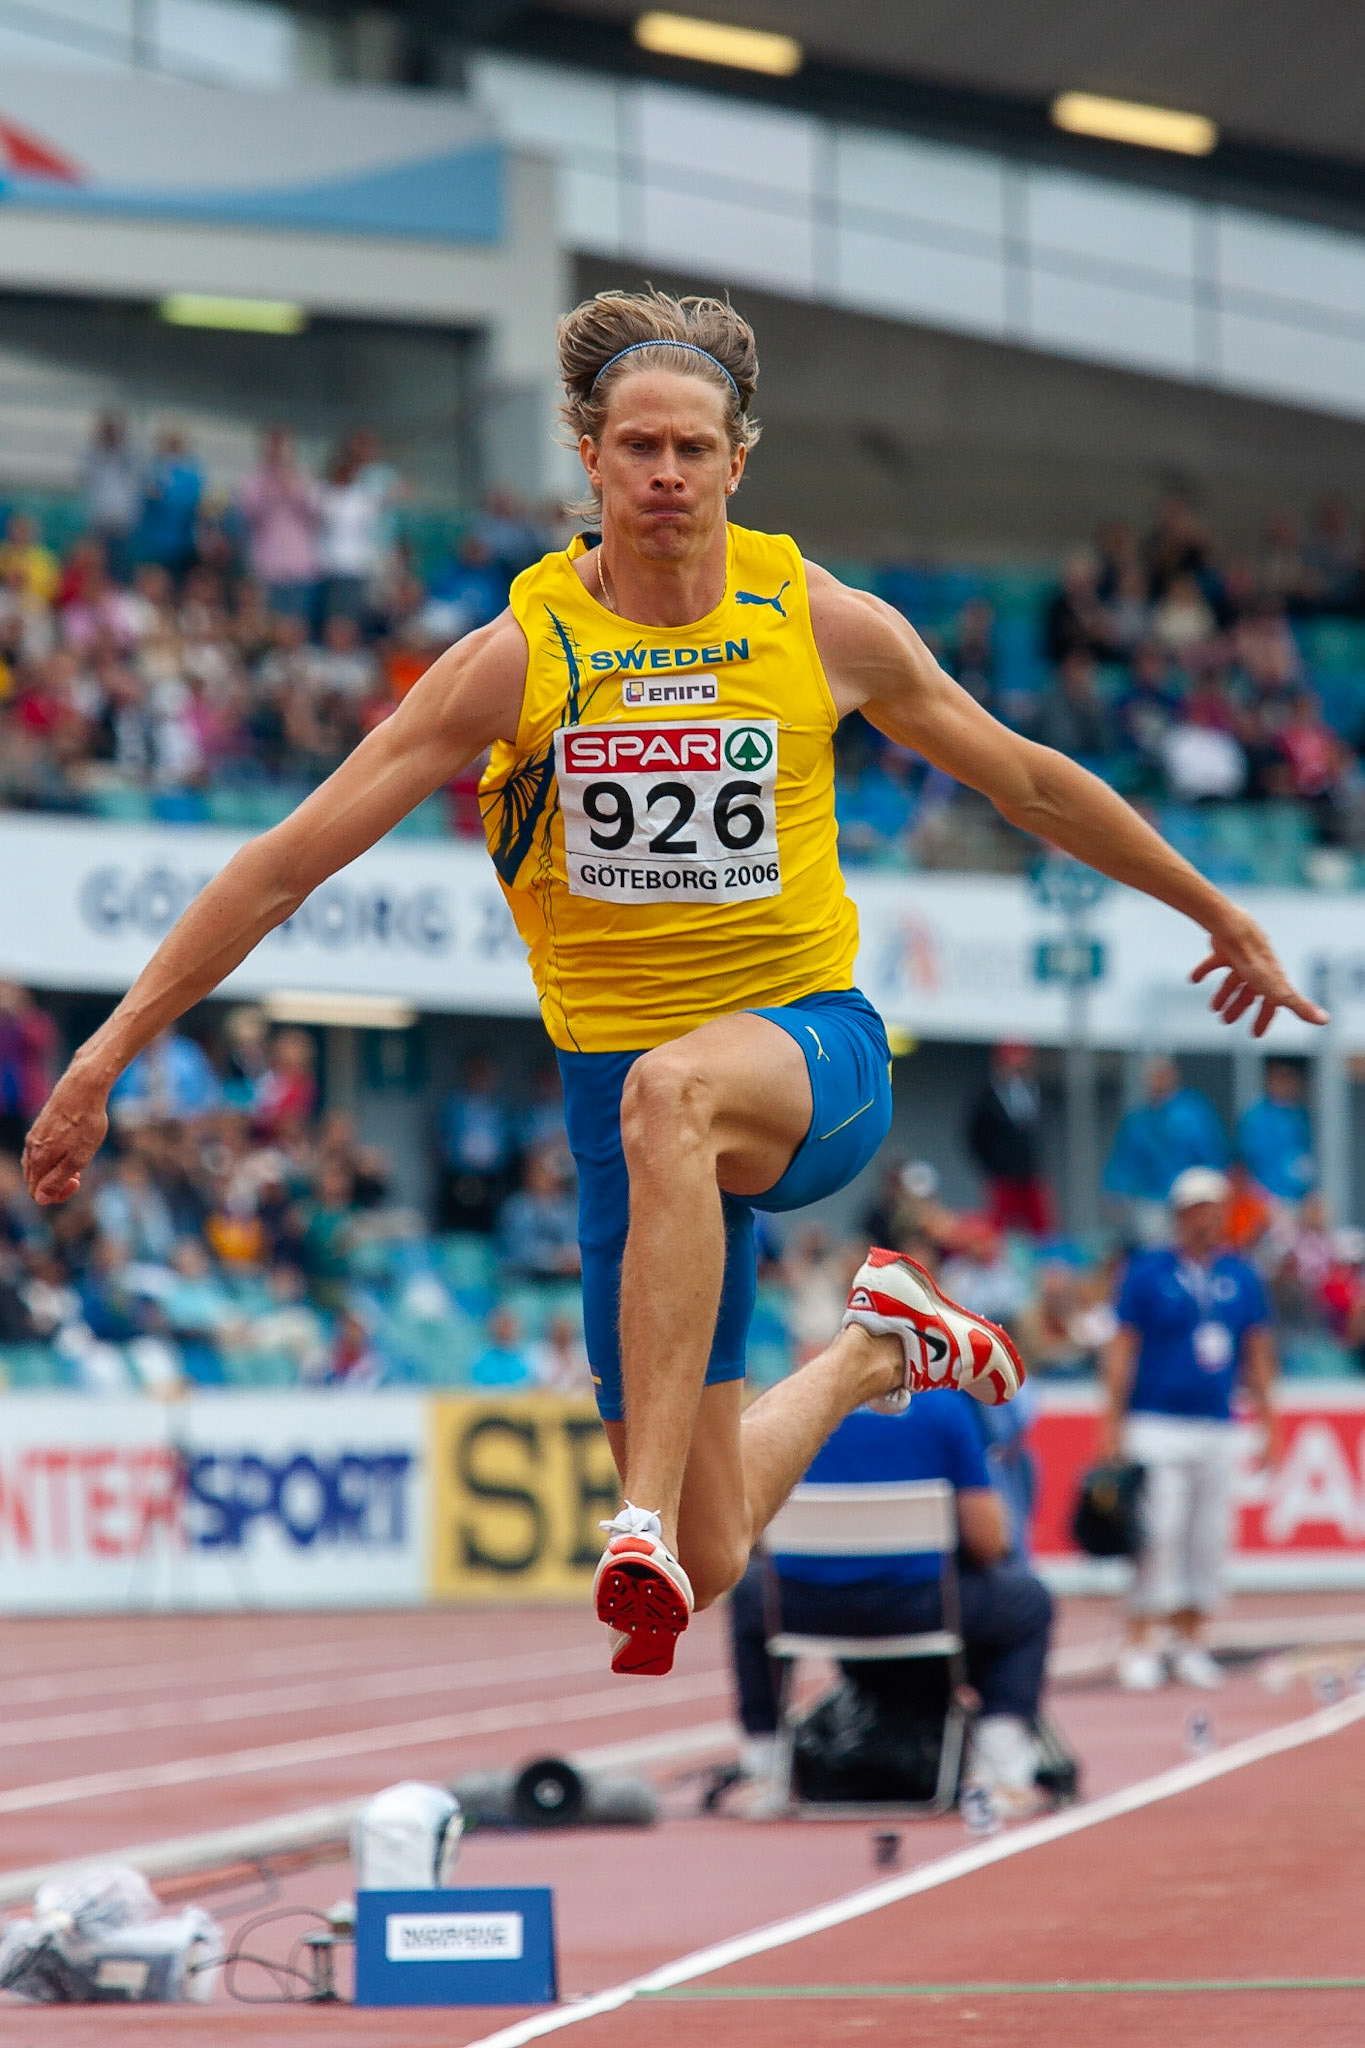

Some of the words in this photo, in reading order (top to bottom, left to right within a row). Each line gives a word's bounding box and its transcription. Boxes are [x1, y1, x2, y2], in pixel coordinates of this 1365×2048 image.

[591, 638, 751, 671] SWEDEN
[570, 734, 718, 768] SPAR
[582, 780, 765, 854] 926
[580, 863, 718, 890] GÖTEBORG
[723, 862, 780, 889] 2006
